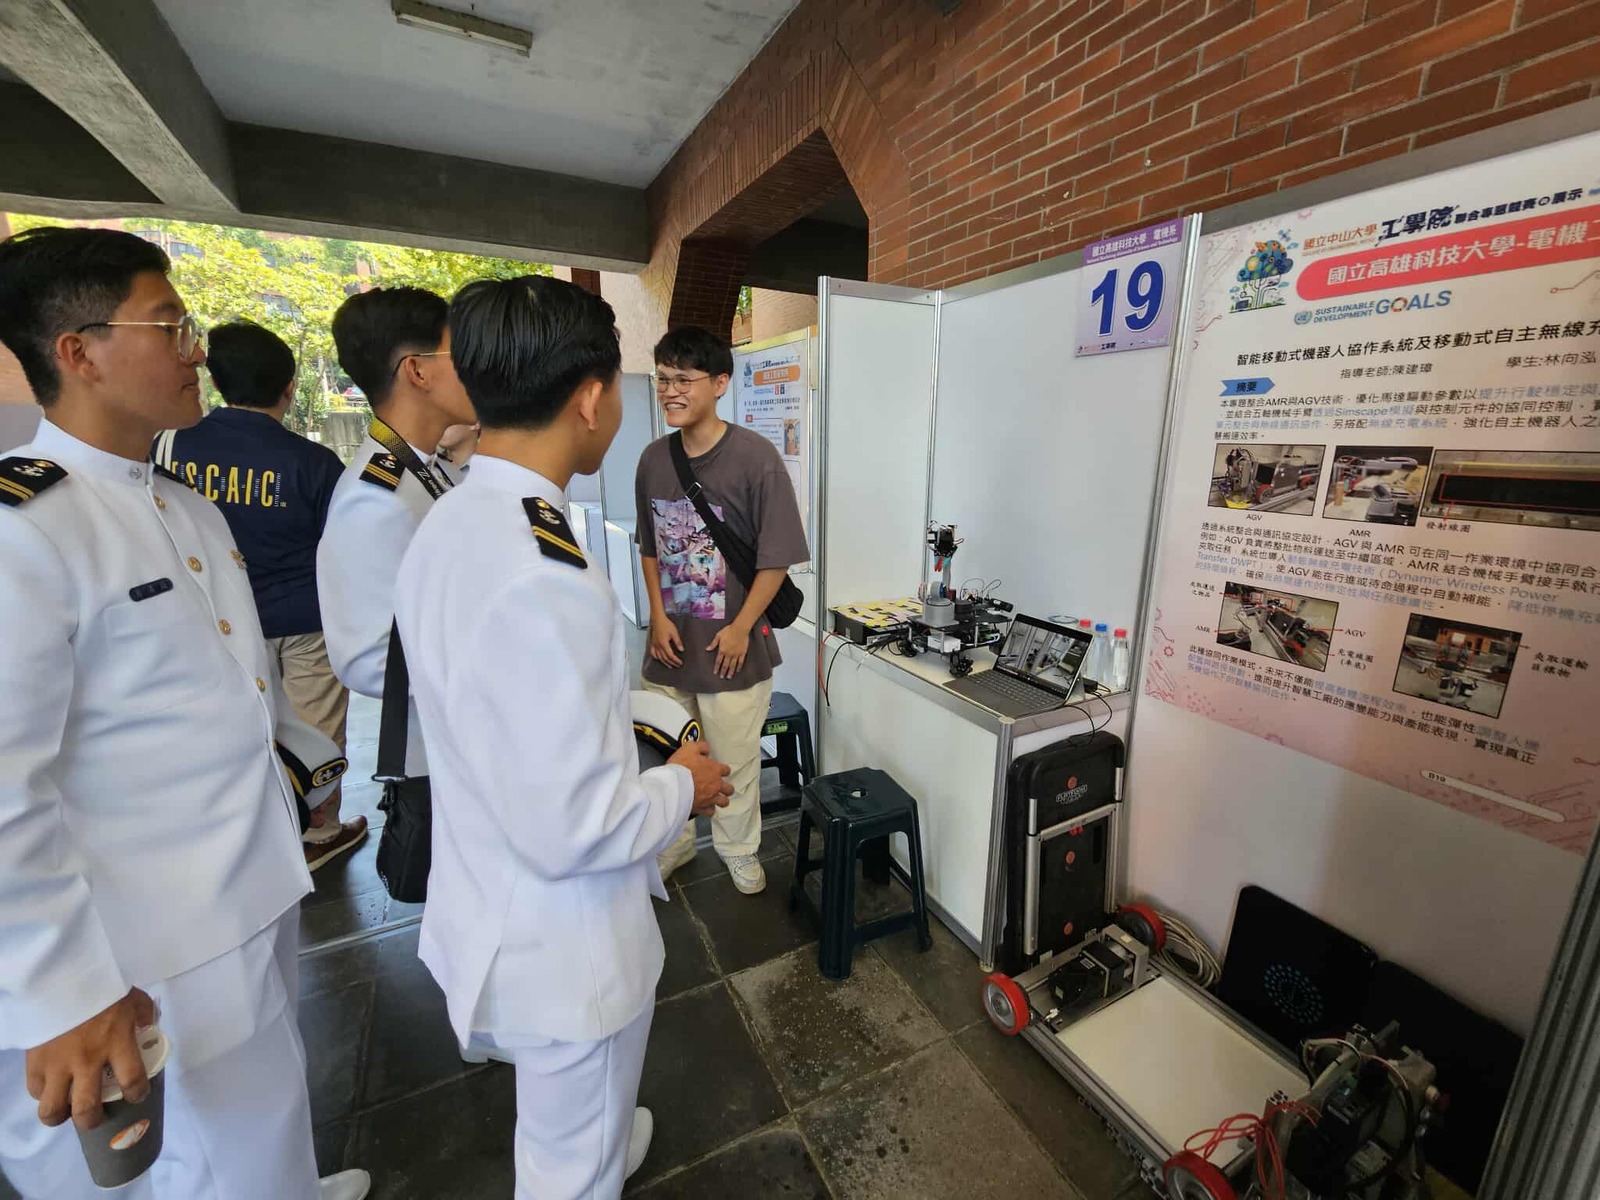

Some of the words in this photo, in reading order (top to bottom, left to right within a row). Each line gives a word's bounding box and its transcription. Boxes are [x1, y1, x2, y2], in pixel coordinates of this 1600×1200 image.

[1303, 223, 1377, 250] 國立中山大學
[1378, 205, 1456, 241] 工學院
[1091, 260, 1165, 336] 19
[1375, 290, 1452, 314] GOALS
[1315, 301, 1375, 315] SUSTAINABLE
[1313, 309, 1373, 323] DEVELOPMENT
[1236, 382, 1257, 393] 摘要
[1246, 513, 1262, 521] AGV
[1349, 529, 1371, 537] AMR
[1376, 543, 1404, 555] AMR
[1288, 566, 1310, 576] AGV
[1388, 568, 1443, 586] Dynamic
[1446, 577, 1505, 595] Wireless
[1510, 586, 1559, 602] Power
[1344, 628, 1366, 638] AGV
